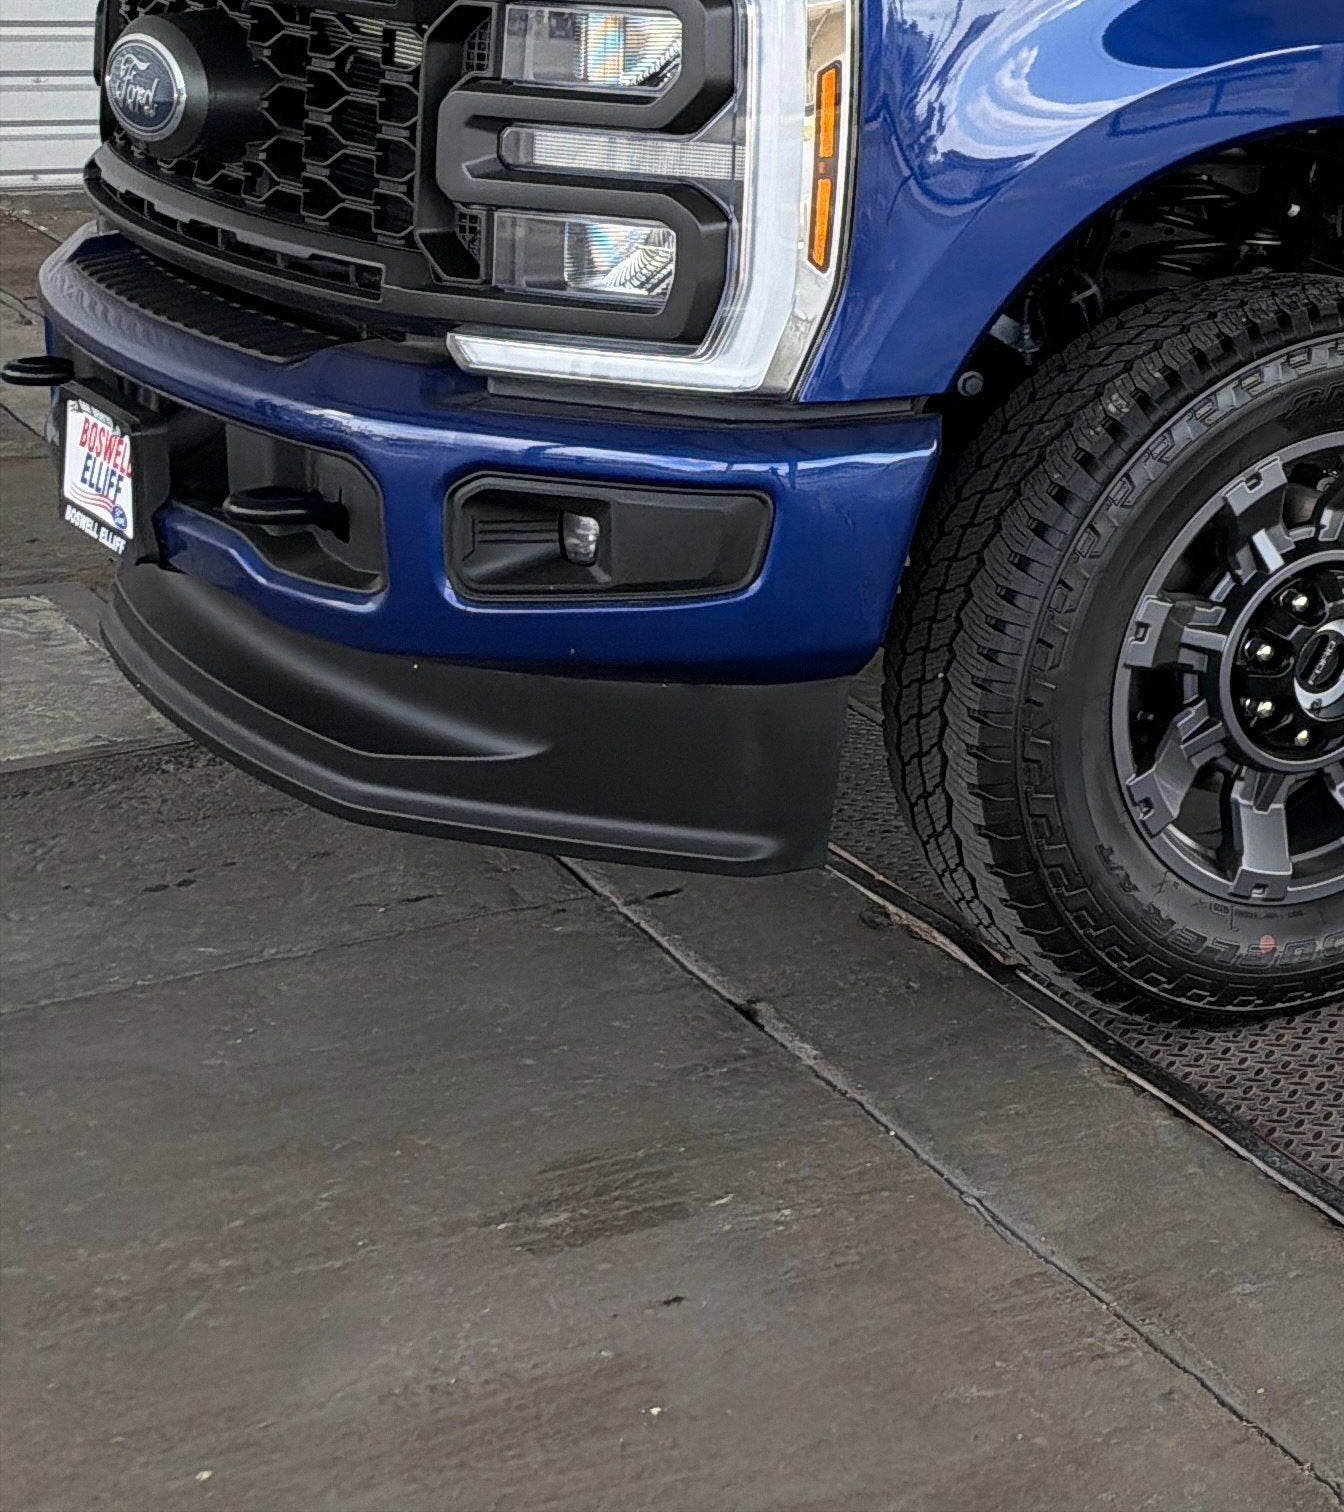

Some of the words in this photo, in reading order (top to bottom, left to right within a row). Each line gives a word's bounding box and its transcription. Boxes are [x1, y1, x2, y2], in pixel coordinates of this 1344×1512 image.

[115, 52, 160, 118] Ford
[80, 452, 124, 506] ELLIFF
[64, 505, 100, 539] BOSWELL
[99, 524, 127, 555] ELLIFF
